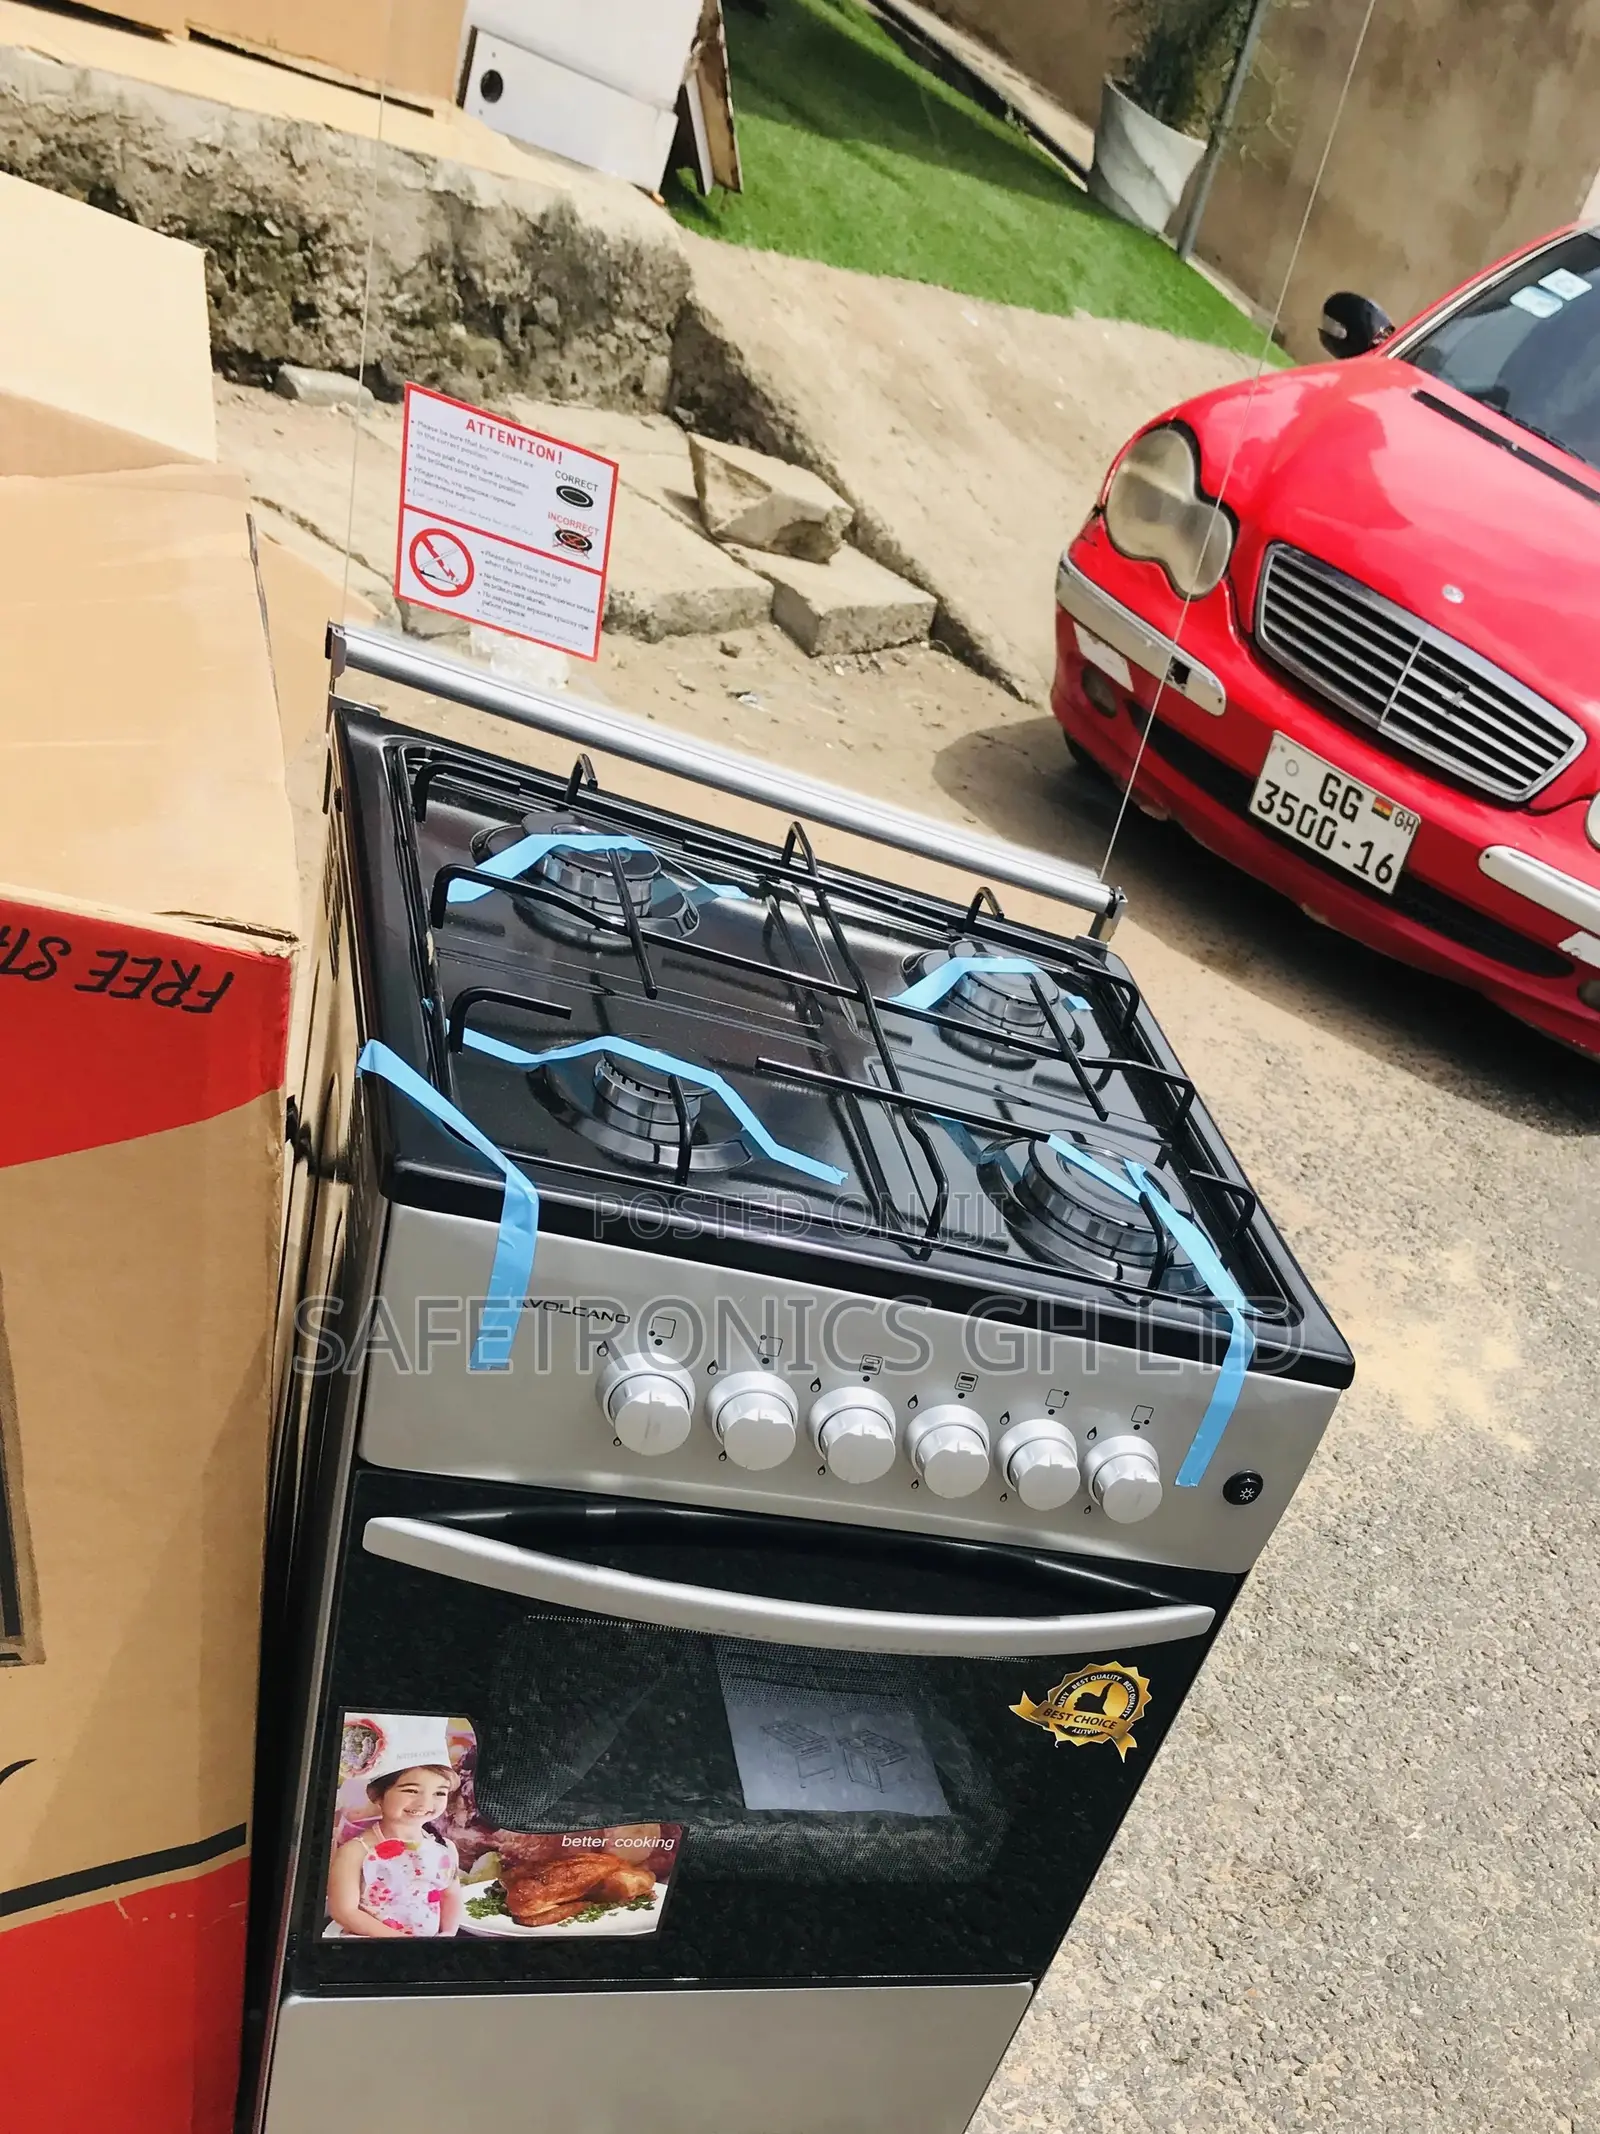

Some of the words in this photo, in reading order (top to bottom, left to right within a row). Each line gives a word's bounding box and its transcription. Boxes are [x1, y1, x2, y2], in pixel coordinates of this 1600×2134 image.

[555, 470, 599, 492] CORRECT
[548, 511, 600, 535] INCORRECT
[1319, 772, 1364, 823] GG
[1394, 811, 1417, 836] GH
[1256, 779, 1395, 885] 3500-16
[0, 924, 72, 981] ST
[74, 950, 235, 1014] FREE
[1071, 1677, 1089, 1690] BEST
[1090, 1673, 1122, 1682] QUALITY
[1123, 1680, 1135, 1693] BEST
[1122, 1692, 1136, 1718] QUALITY
[1043, 1708, 1074, 1721] BEST
[1073, 1714, 1118, 1730] CHOICE
[561, 1834, 609, 1848] better
[614, 1836, 676, 1851] cooking
